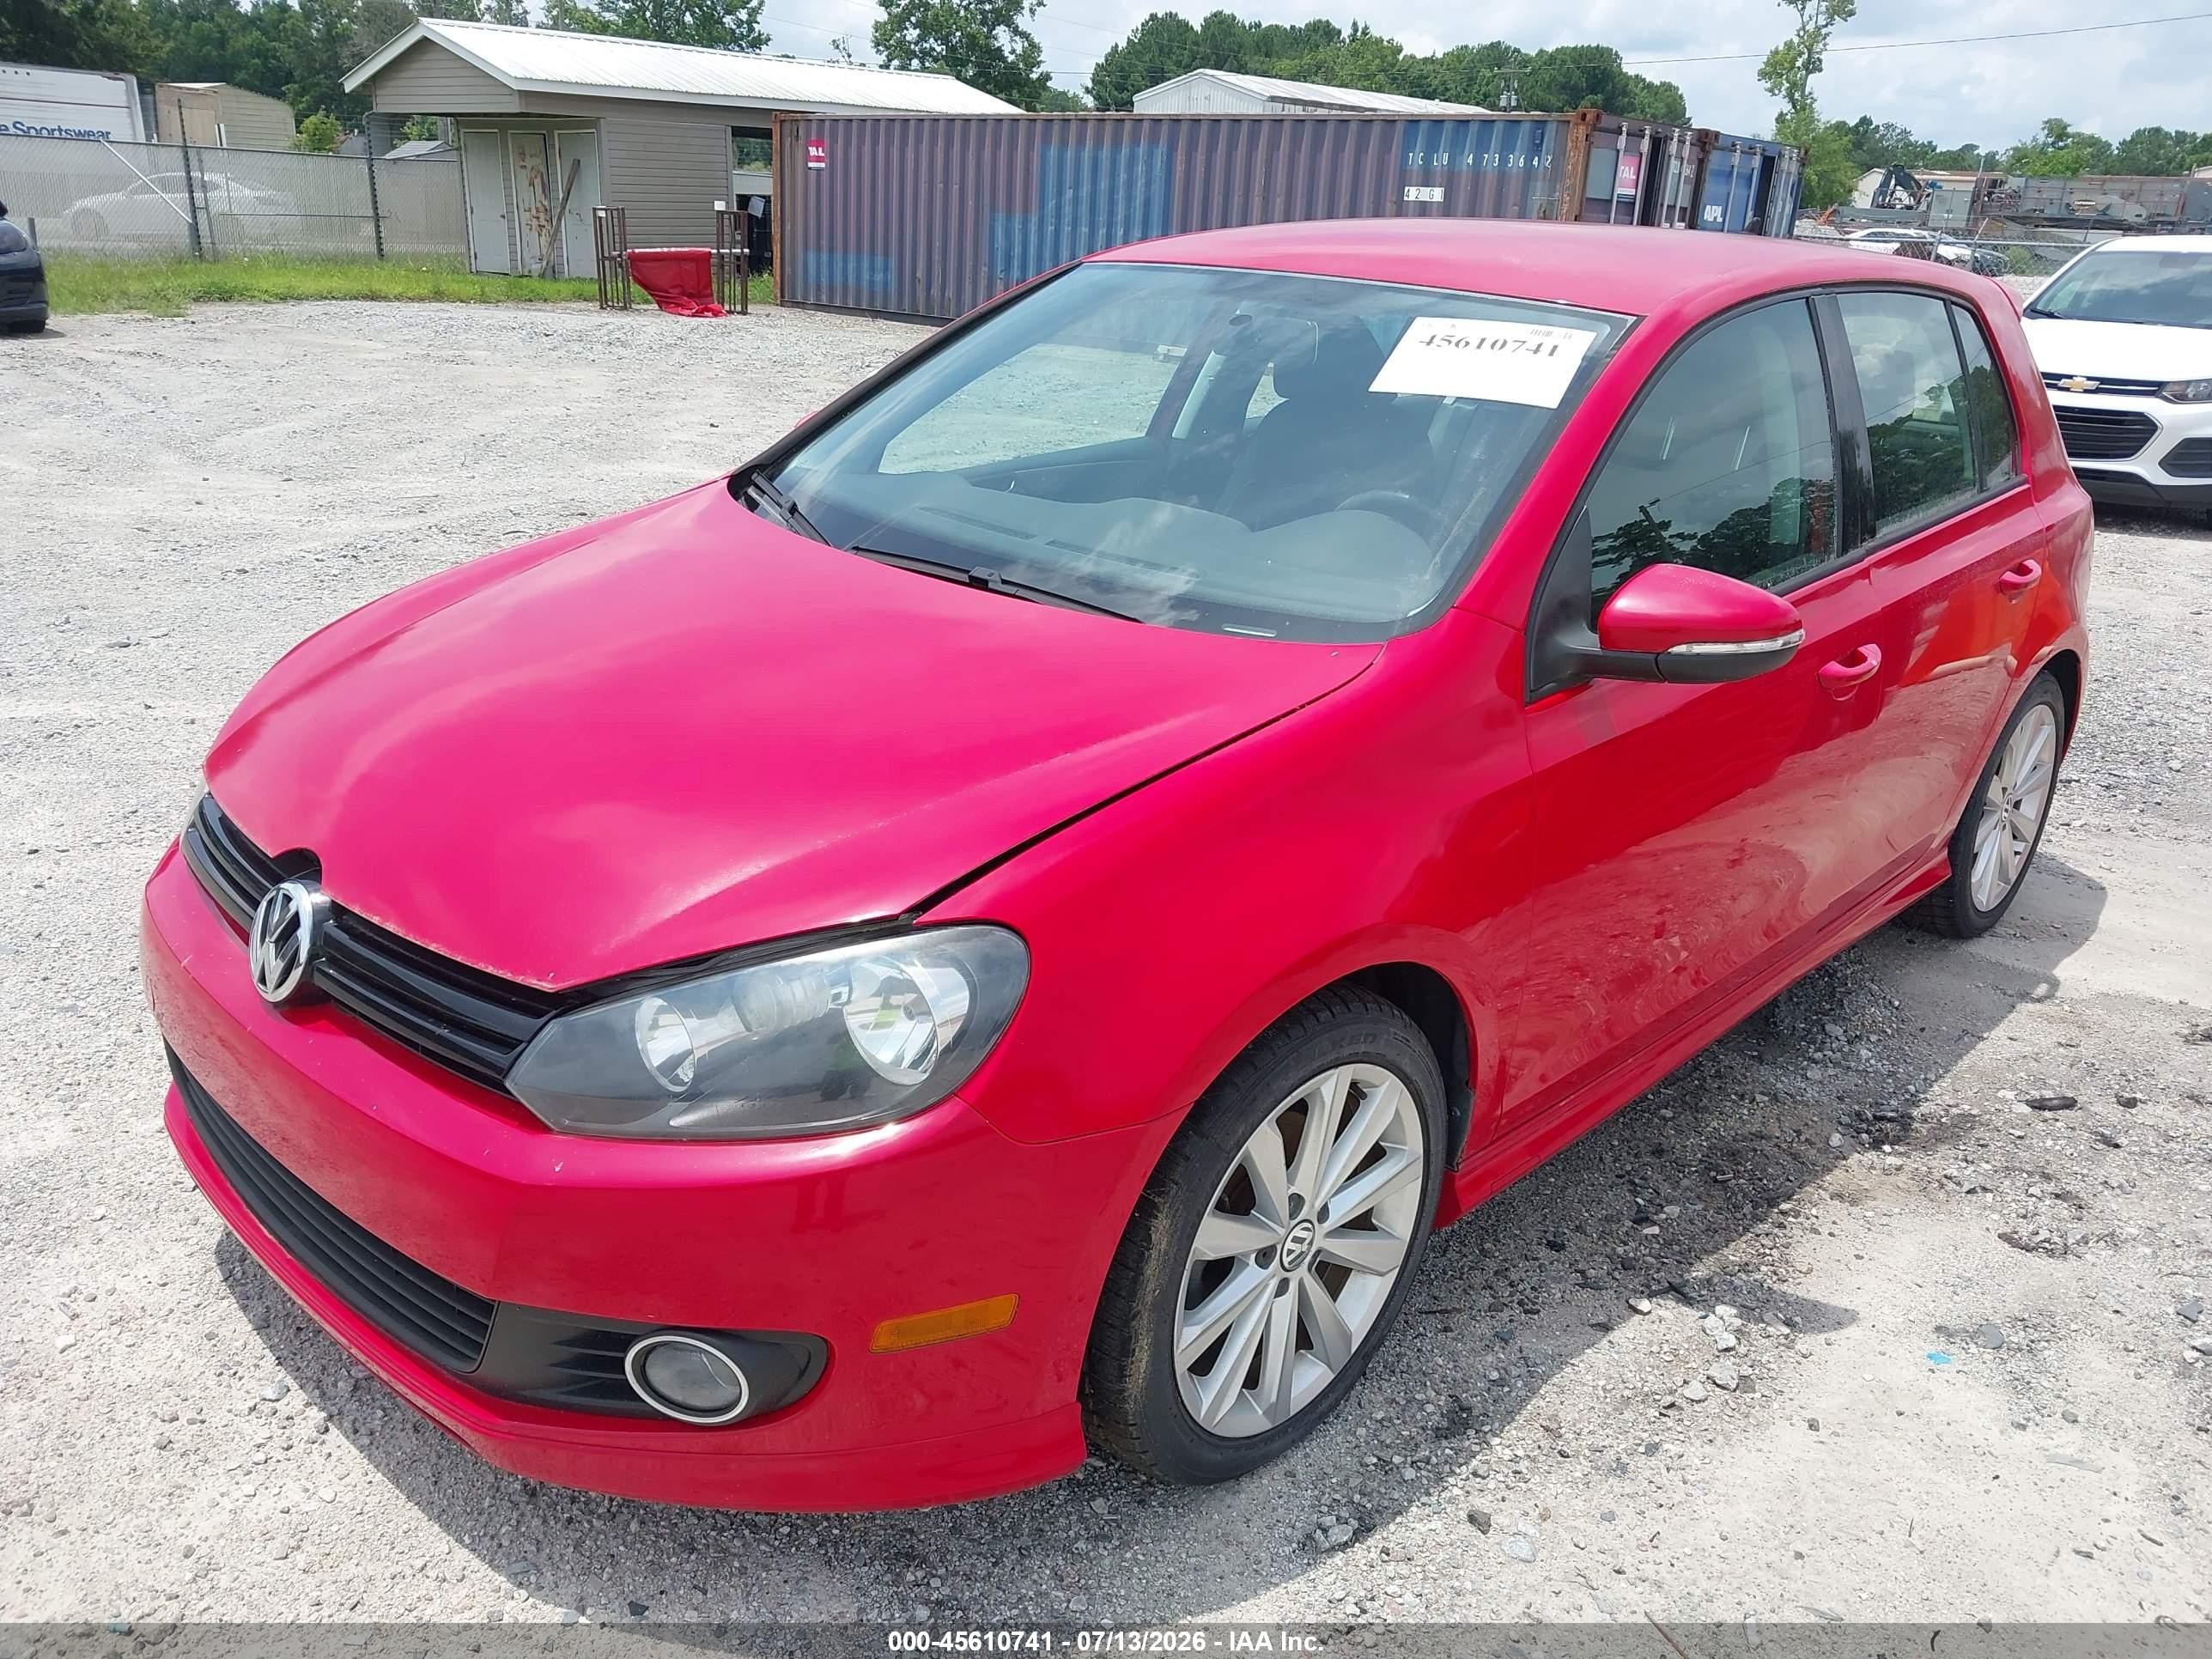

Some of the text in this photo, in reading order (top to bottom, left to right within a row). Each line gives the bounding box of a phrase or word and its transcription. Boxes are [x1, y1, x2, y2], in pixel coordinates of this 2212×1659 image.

[808, 146, 825, 156] TAL
[1620, 165, 1636, 179] TAL
[1704, 204, 1723, 222] APL
[1419, 334, 1559, 356] 45610741
